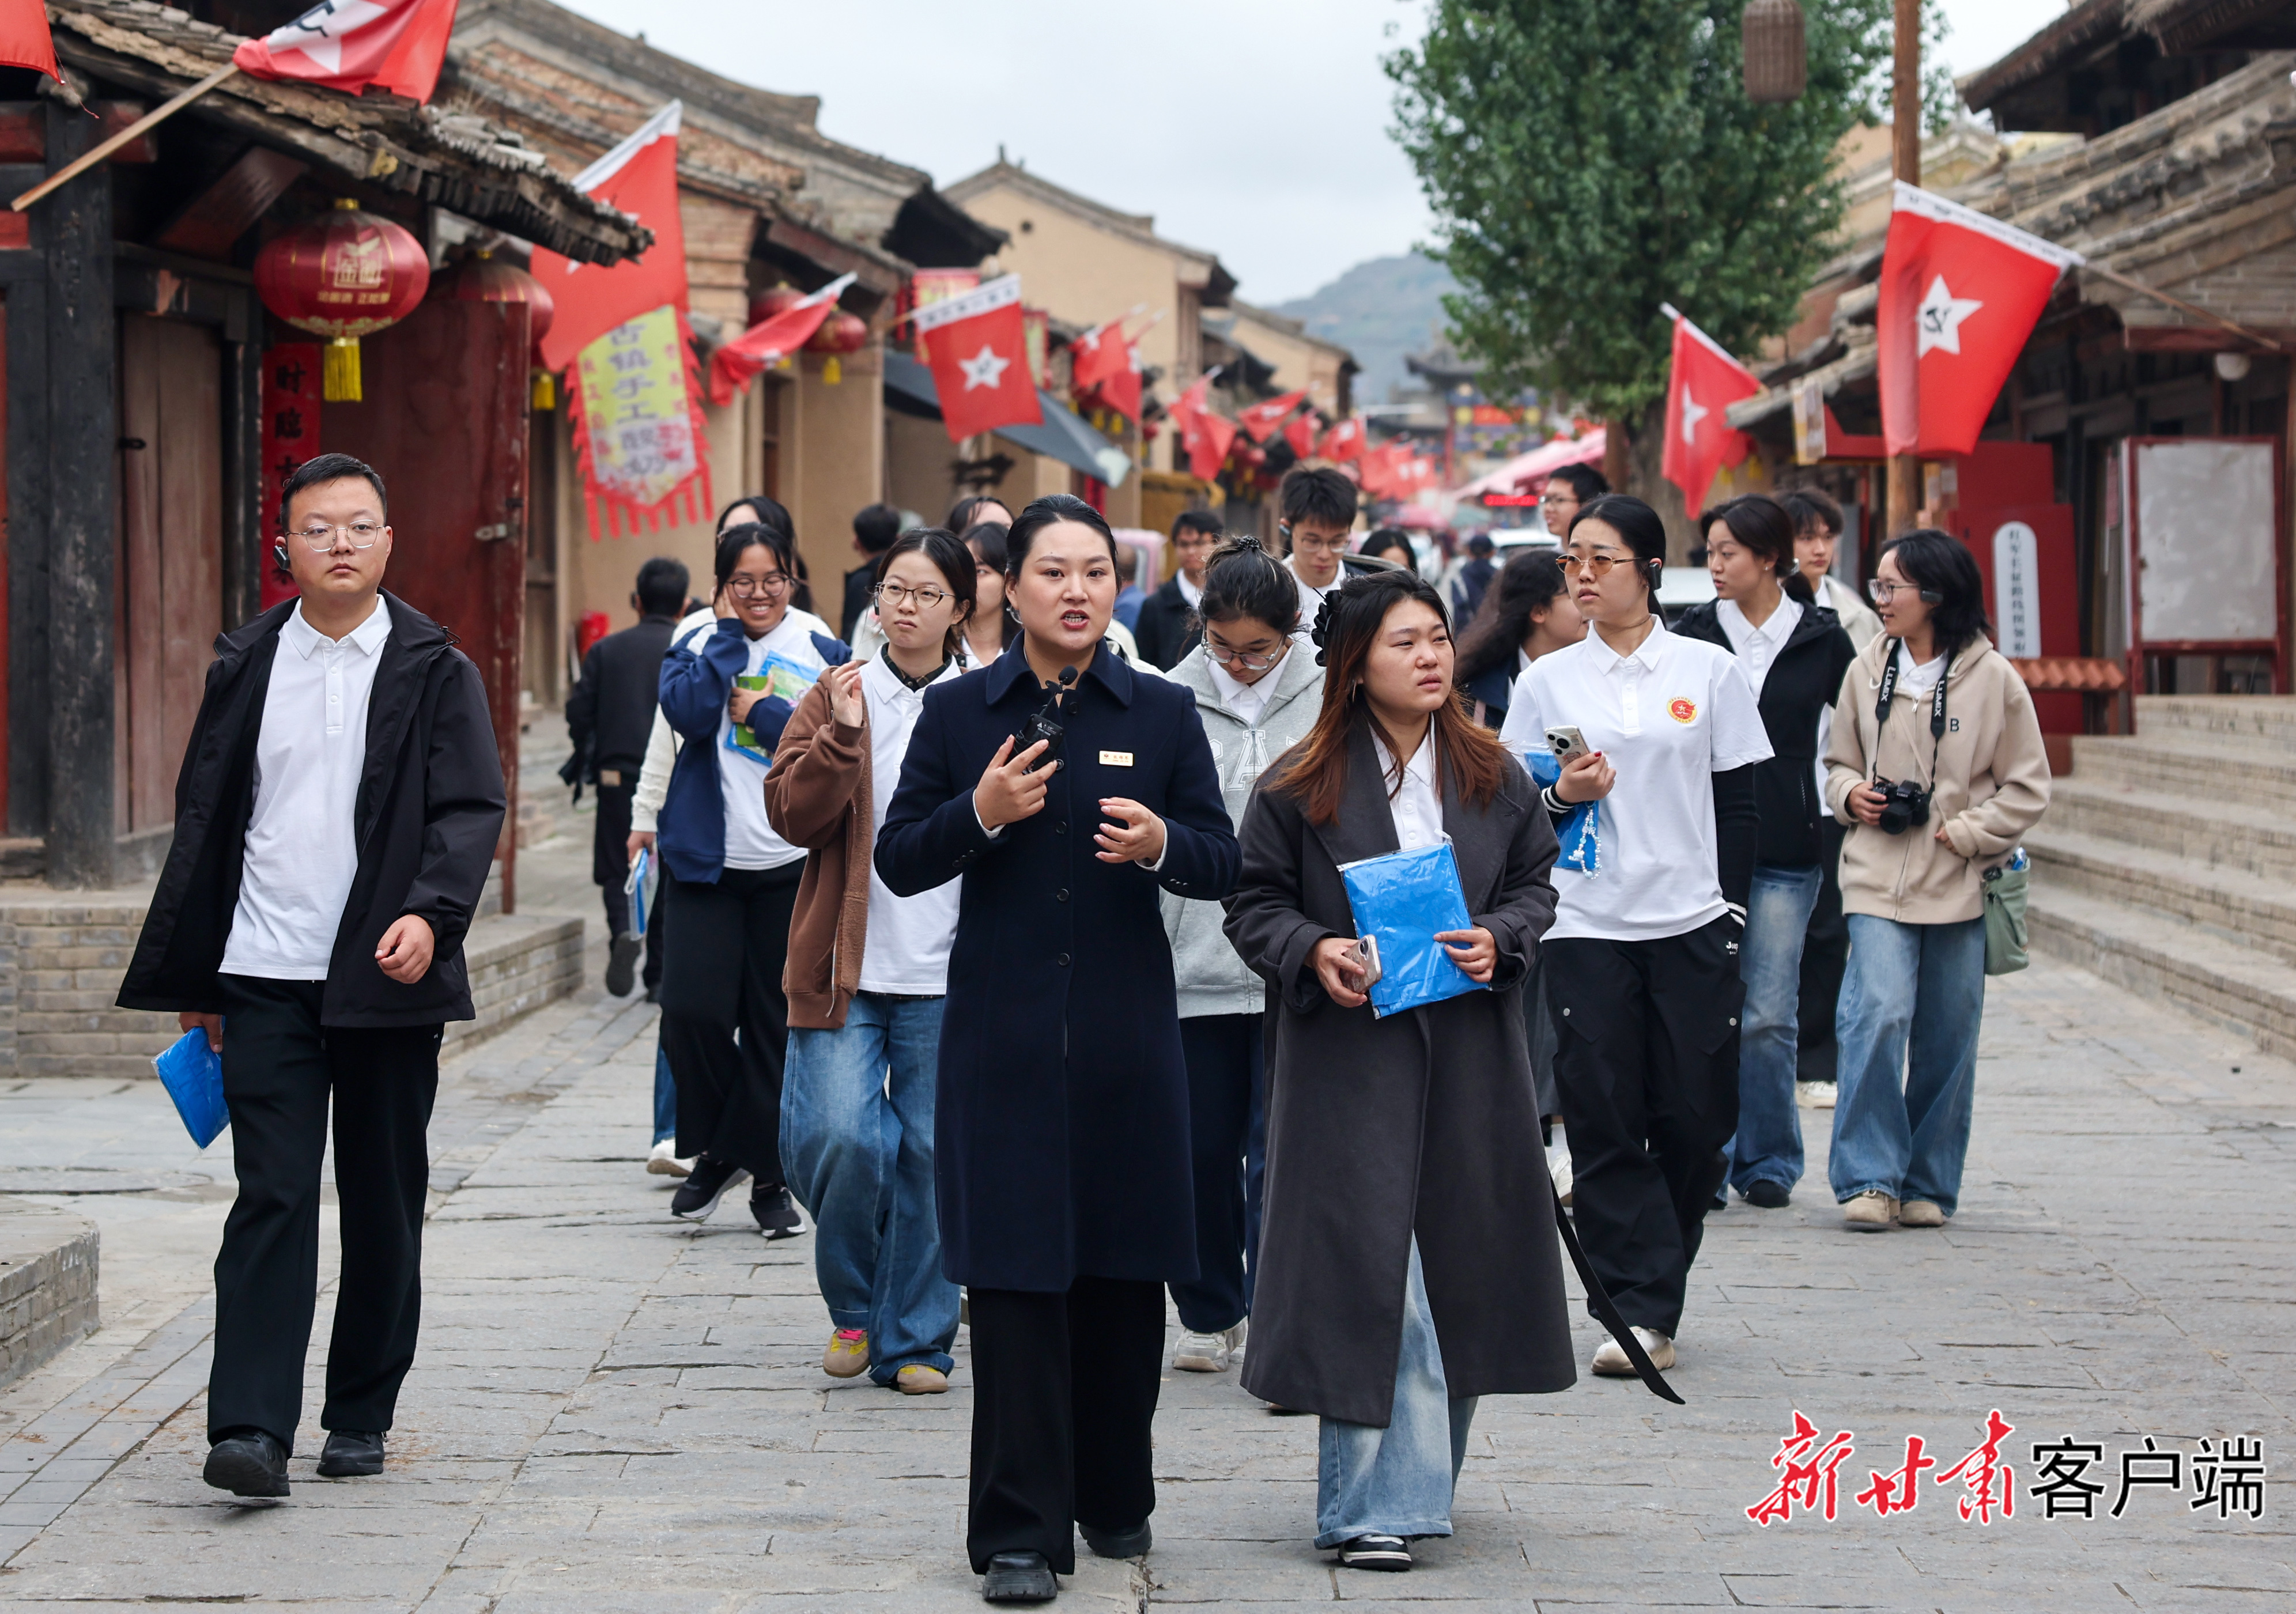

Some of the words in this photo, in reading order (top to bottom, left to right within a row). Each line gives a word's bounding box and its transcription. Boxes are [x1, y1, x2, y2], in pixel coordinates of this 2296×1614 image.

[1880, 666, 1897, 702] LUMIX
[1934, 680, 1945, 717] LUMIX
[1950, 718, 1959, 732] B
